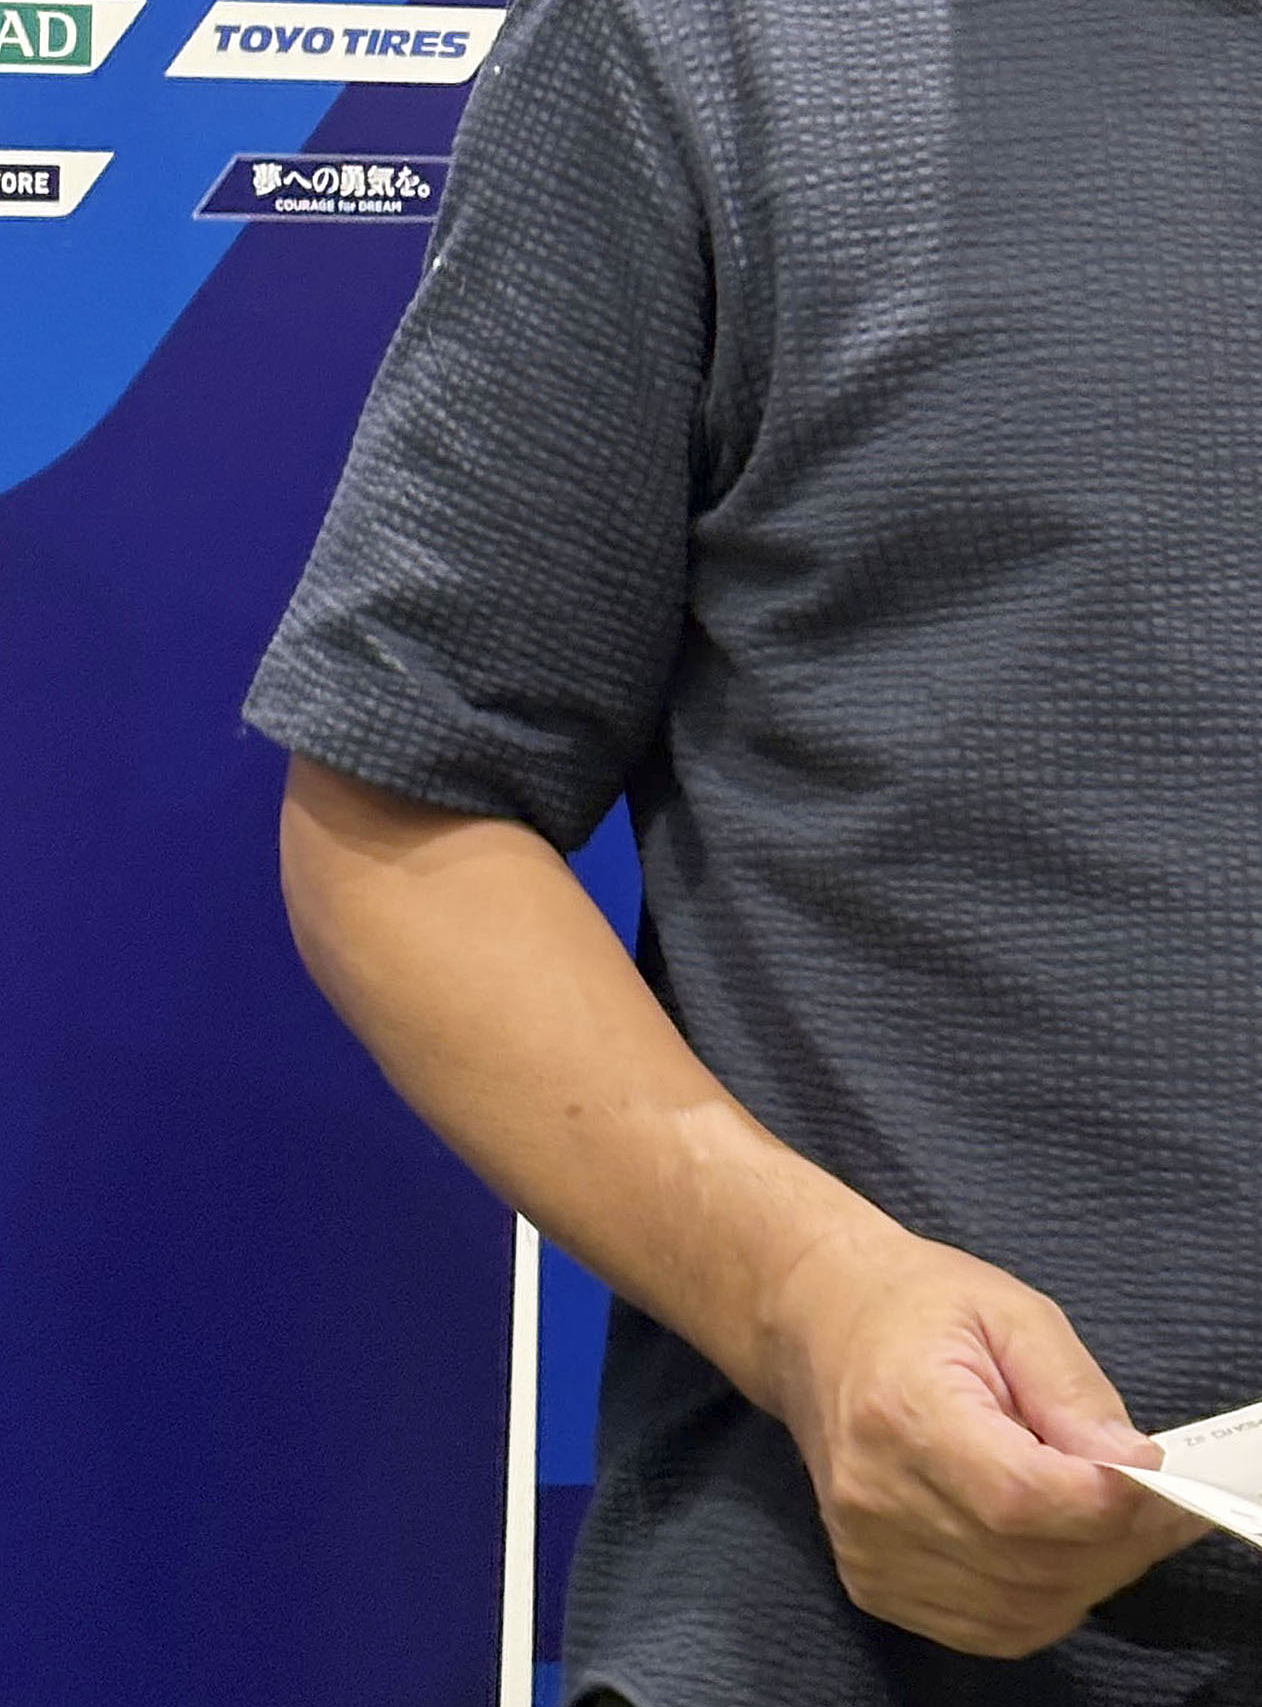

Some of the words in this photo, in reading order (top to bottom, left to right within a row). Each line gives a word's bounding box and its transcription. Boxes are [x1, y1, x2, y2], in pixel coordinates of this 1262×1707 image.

[214, 25, 335, 54] TOYO
[342, 28, 470, 58] TIRES
[0, 171, 50, 195] ORE
[275, 199, 335, 213] COURAGE
[358, 199, 402, 213] DREAM
